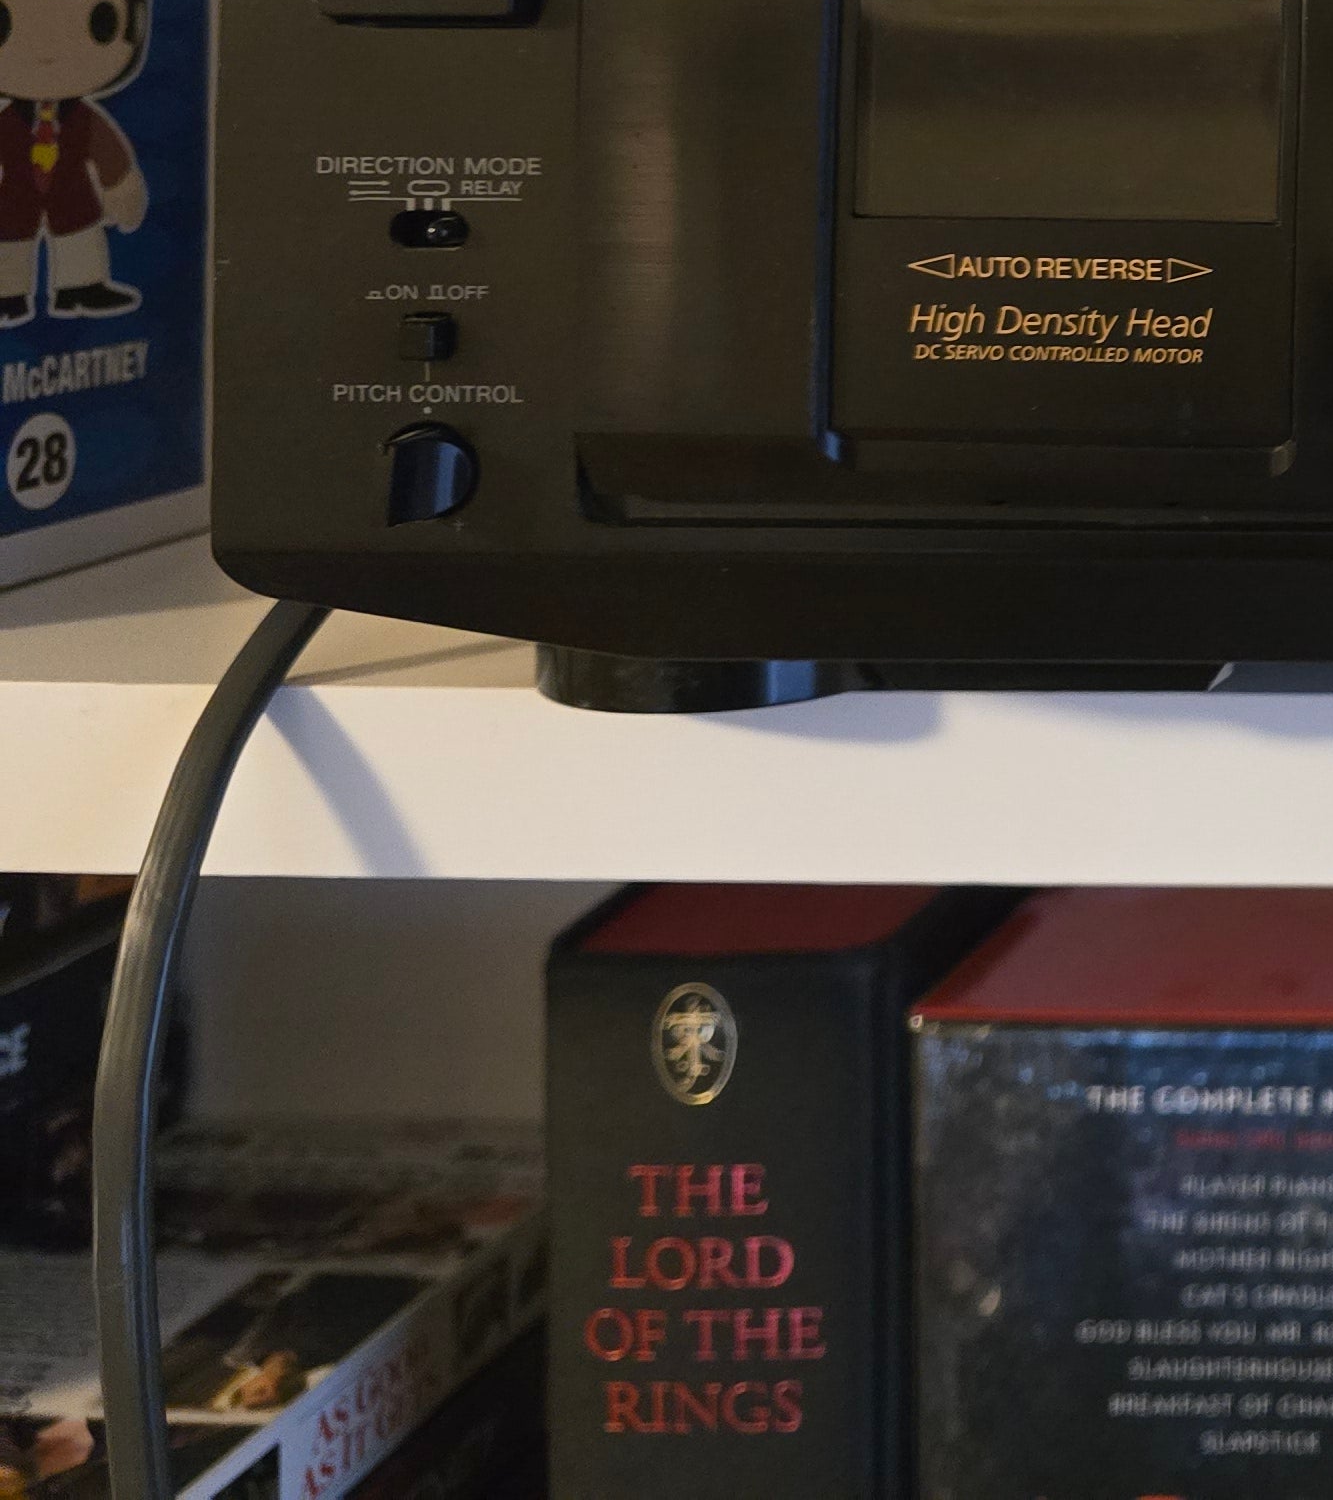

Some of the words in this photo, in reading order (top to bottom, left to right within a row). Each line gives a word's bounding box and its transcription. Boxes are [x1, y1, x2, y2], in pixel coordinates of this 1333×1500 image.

[315, 156, 454, 175] DIRECTION
[464, 157, 542, 176] MODE
[460, 180, 523, 196] RELAY
[958, 256, 1031, 279] AUTO
[1035, 257, 1164, 282] REVERSE
[386, 284, 419, 301] ON
[447, 285, 489, 301] OFF
[908, 303, 986, 342] High
[996, 305, 1119, 344] Density
[1125, 307, 1213, 339] Head
[914, 344, 942, 360] DC
[944, 344, 1004, 361] SERVO
[1009, 345, 1129, 363] CONTROLLED
[1133, 348, 1204, 364] MOTOR
[3, 339, 149, 404] McCARTNEY
[332, 384, 401, 401] PITCH
[408, 385, 524, 403] CONTROL
[16, 433, 67, 491] 28
[1086, 1085, 1146, 1115] THE
[1152, 1085, 1314, 1116] COMPLETE
[626, 1163, 769, 1216] THE
[607, 1235, 795, 1290] LORD
[583, 1307, 668, 1361] OF
[682, 1306, 827, 1361] THE
[603, 1379, 804, 1434] RINGS
